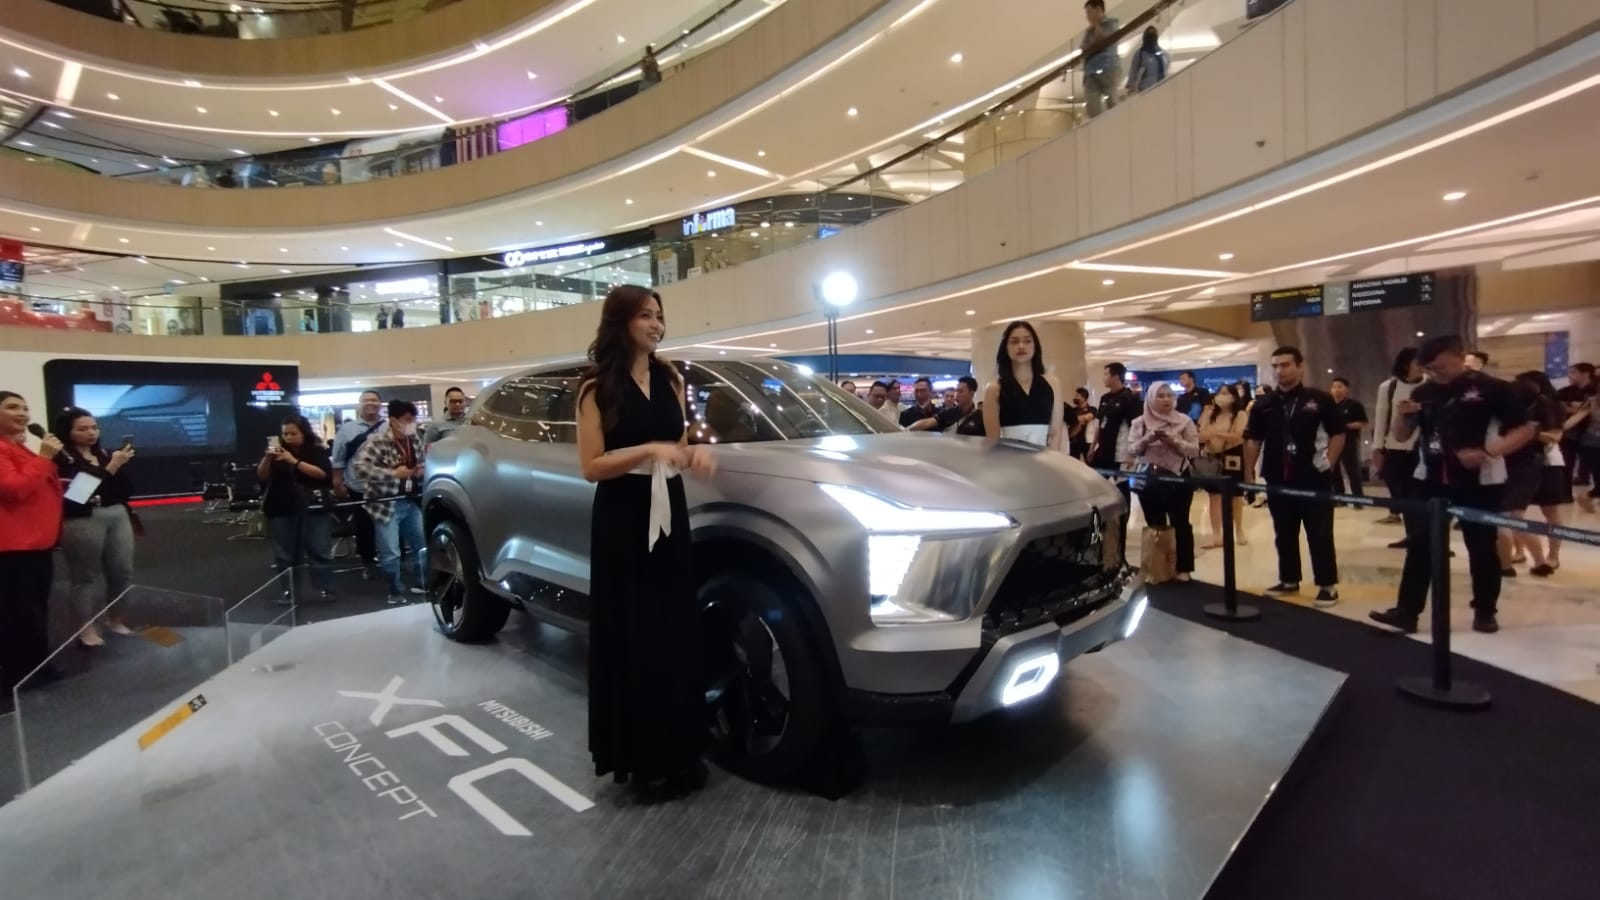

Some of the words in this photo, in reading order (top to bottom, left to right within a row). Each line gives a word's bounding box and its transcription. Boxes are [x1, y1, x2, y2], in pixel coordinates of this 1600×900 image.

[682, 207, 736, 236] informa
[1335, 297, 1346, 311] 2
[477, 699, 554, 741] MITSUBISHI
[312, 720, 438, 821] CONCEPT
[336, 675, 596, 837] XFC
